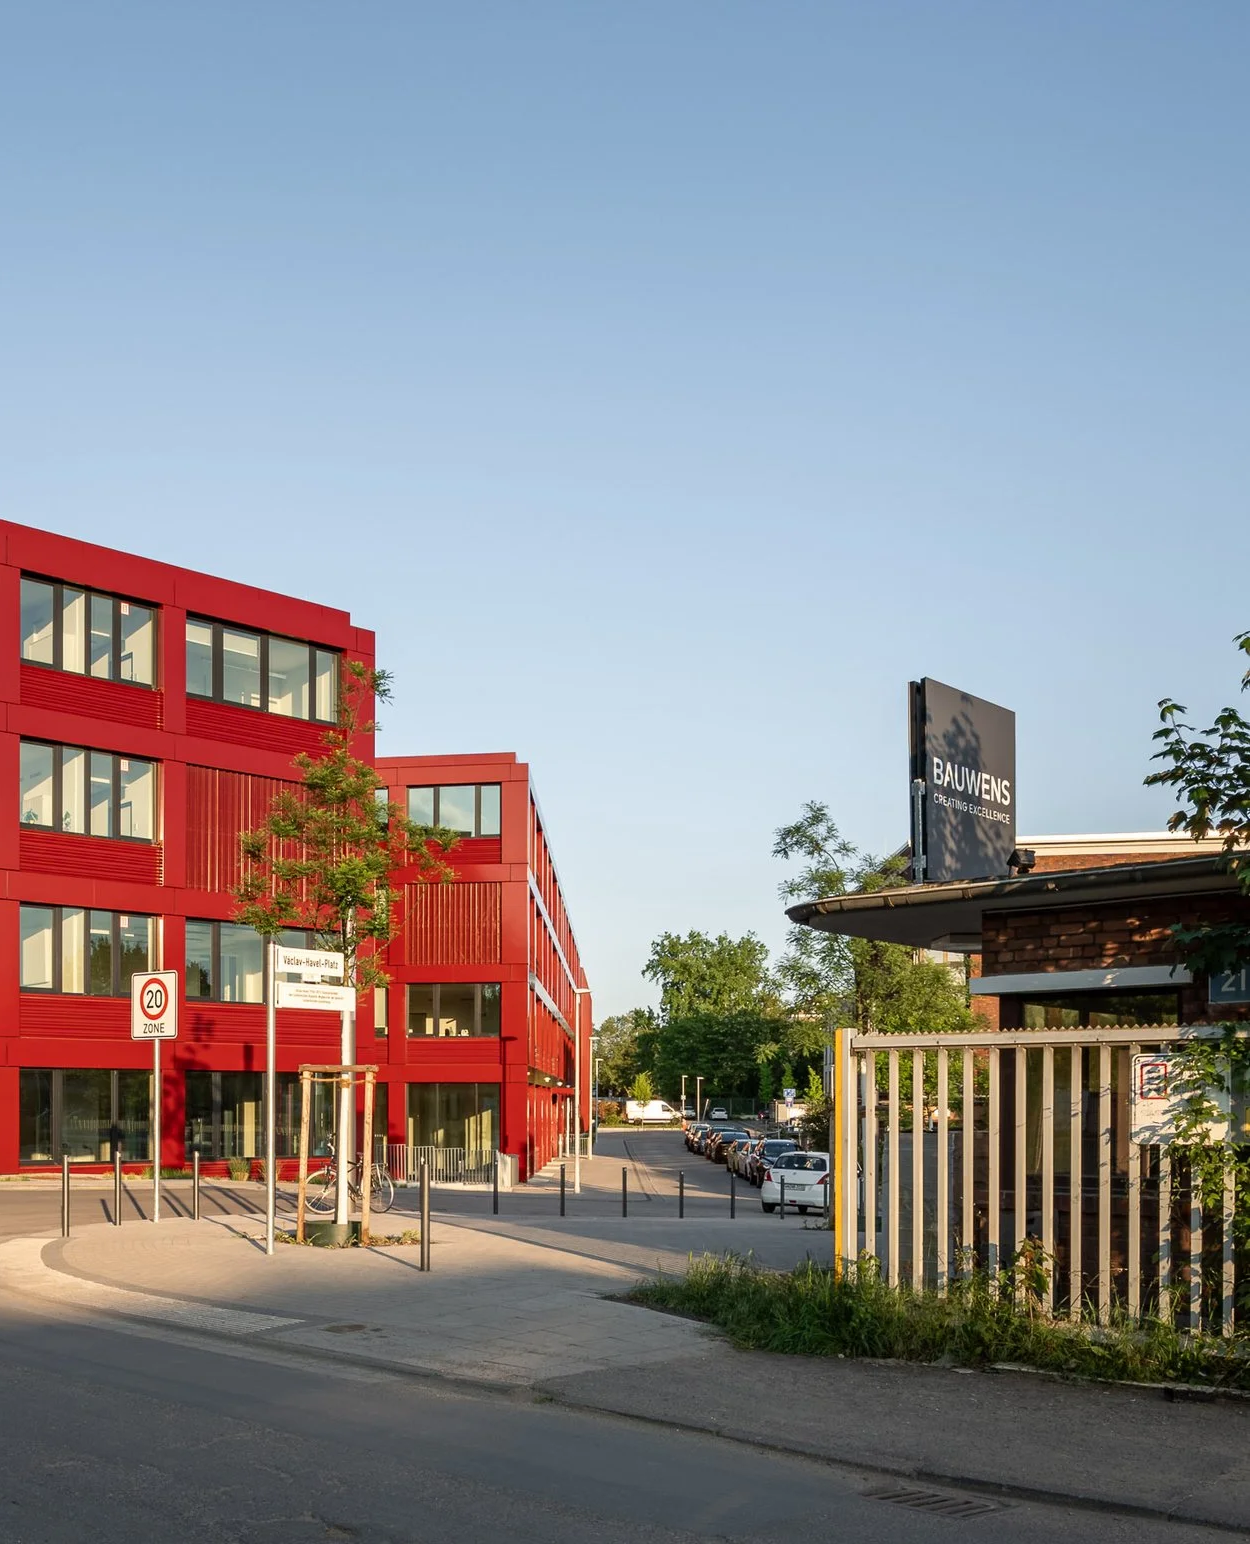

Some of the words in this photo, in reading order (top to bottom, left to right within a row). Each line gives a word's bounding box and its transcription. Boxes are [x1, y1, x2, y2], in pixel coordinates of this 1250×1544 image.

[933, 756, 1010, 806] BAUWENS
[933, 793, 968, 812] CREATING
[968, 803, 1010, 825] EXCELLENCE
[1221, 969, 1246, 991] 21
[146, 989, 163, 1009] 20
[143, 1022, 165, 1034] ZONE
